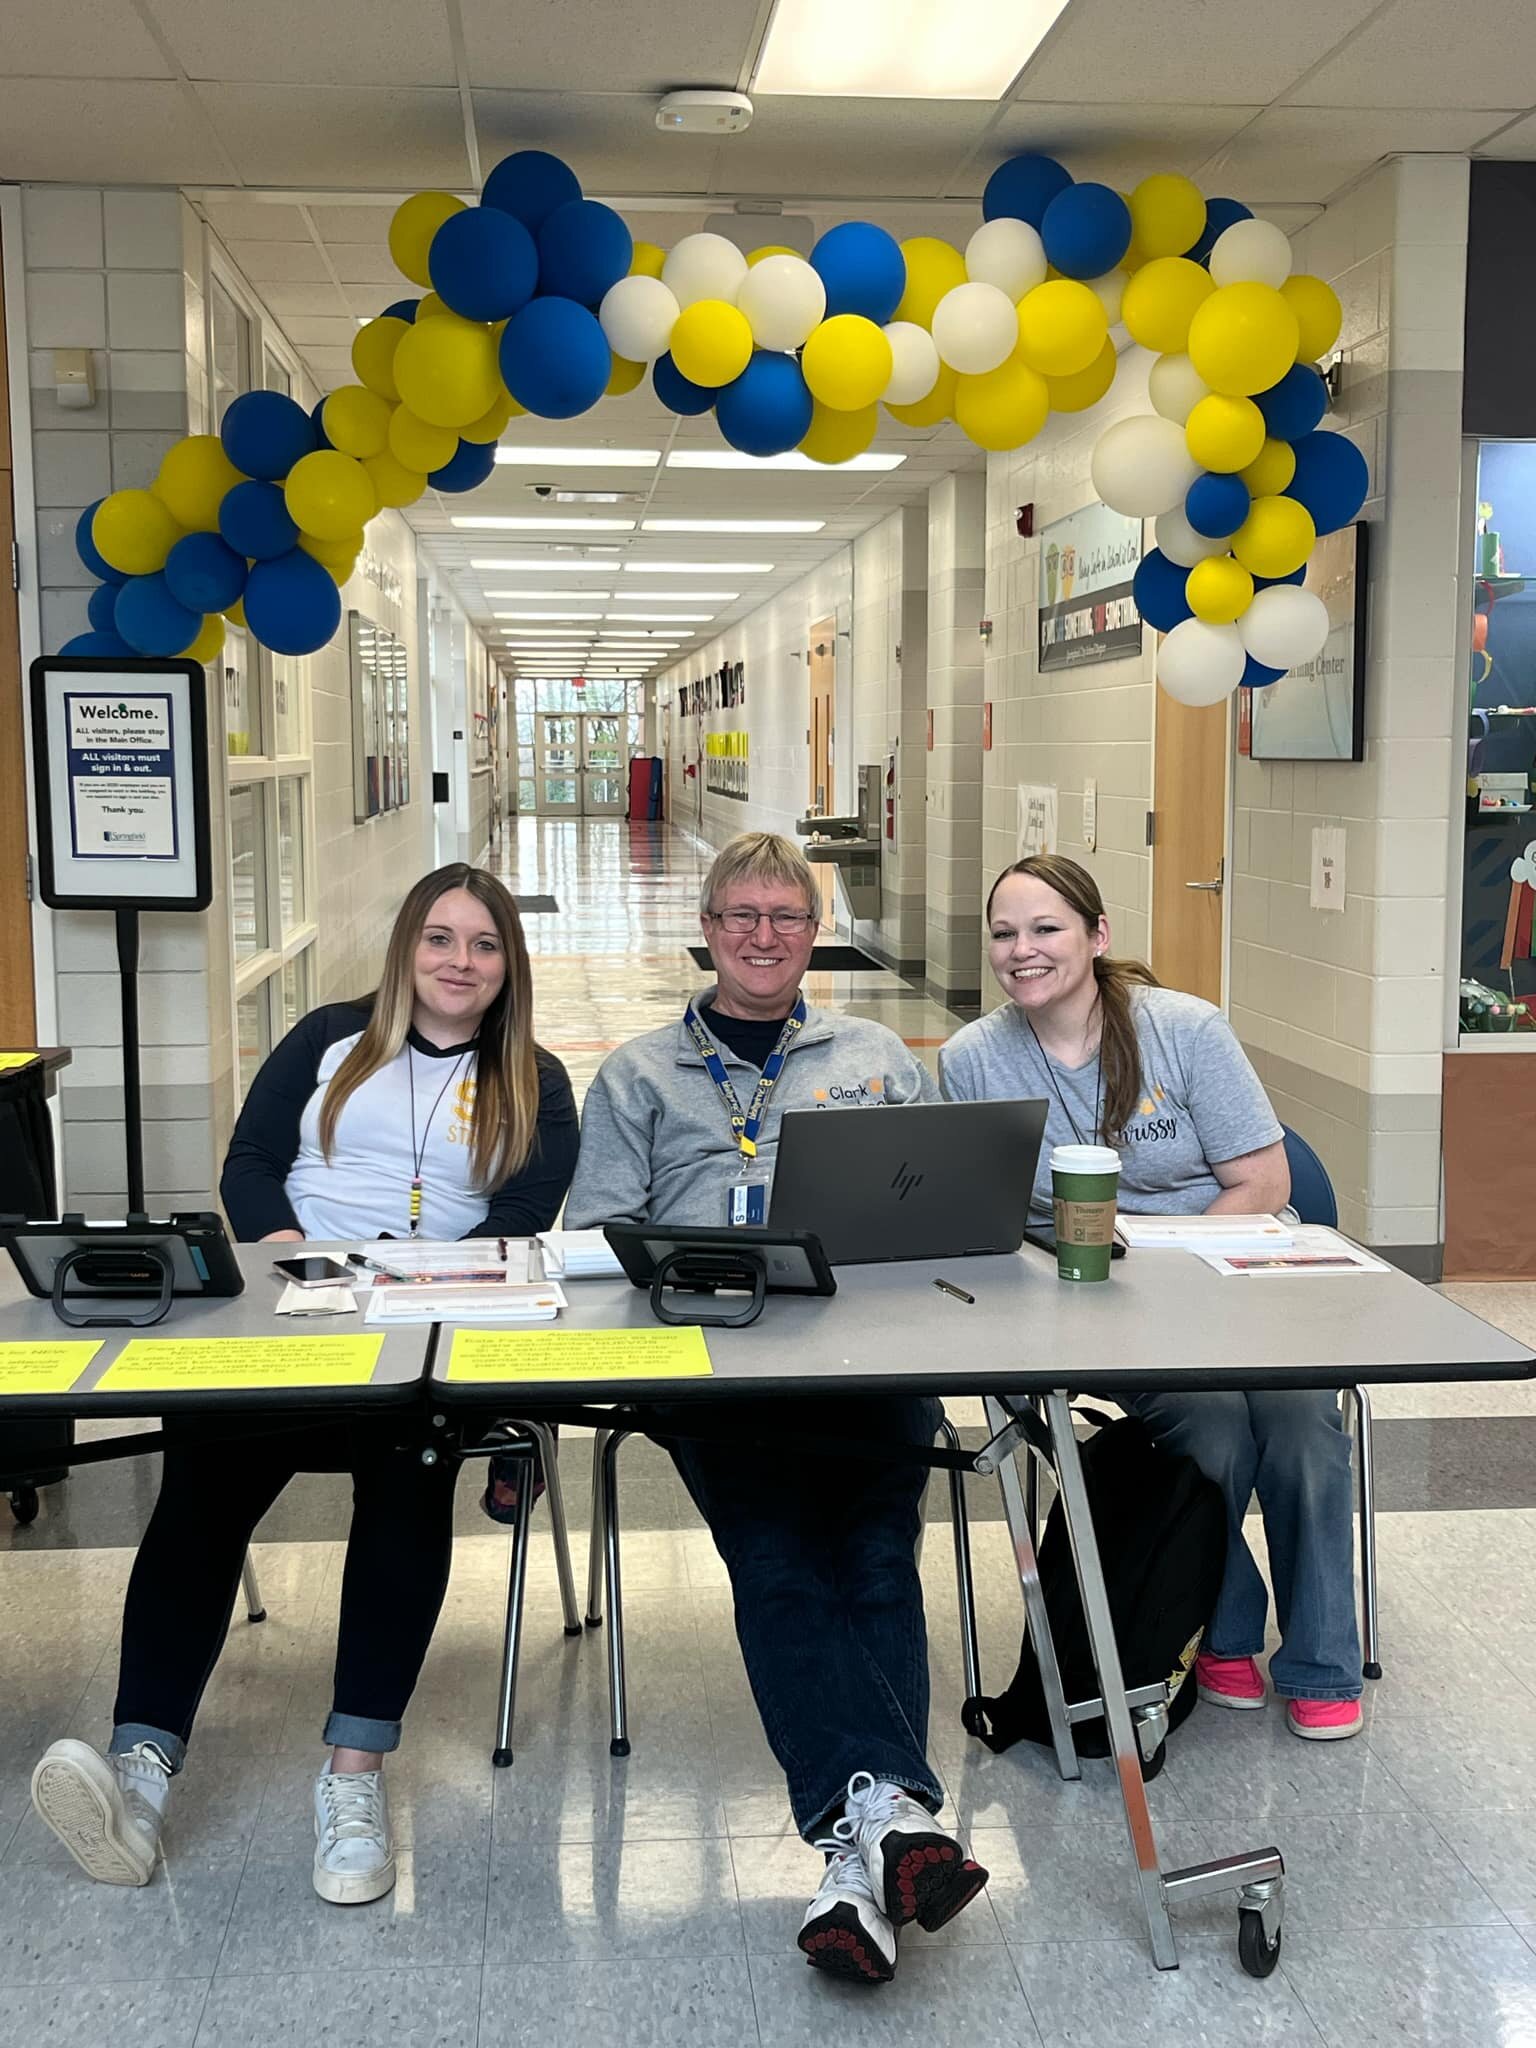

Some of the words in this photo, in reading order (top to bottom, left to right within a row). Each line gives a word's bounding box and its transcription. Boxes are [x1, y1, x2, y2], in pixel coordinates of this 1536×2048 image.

[1316, 656, 1345, 676] Center
[79, 704, 159, 719] Welcome.
[75, 727, 90, 735] ALL
[92, 727, 121, 736] visitors,
[122, 728, 146, 736] please
[148, 728, 165, 737] stop
[82, 753, 101, 761] ALL
[102, 752, 135, 761] visitors
[137, 753, 161, 762] must
[91, 764, 111, 774] sign
[113, 763, 122, 772] in
[123, 764, 132, 772] &
[133, 764, 153, 773] out.
[101, 805, 126, 814] Thank
[128, 807, 146, 816] you.
[829, 1084, 869, 1100] Clark
[890, 1160, 925, 1201] hp
